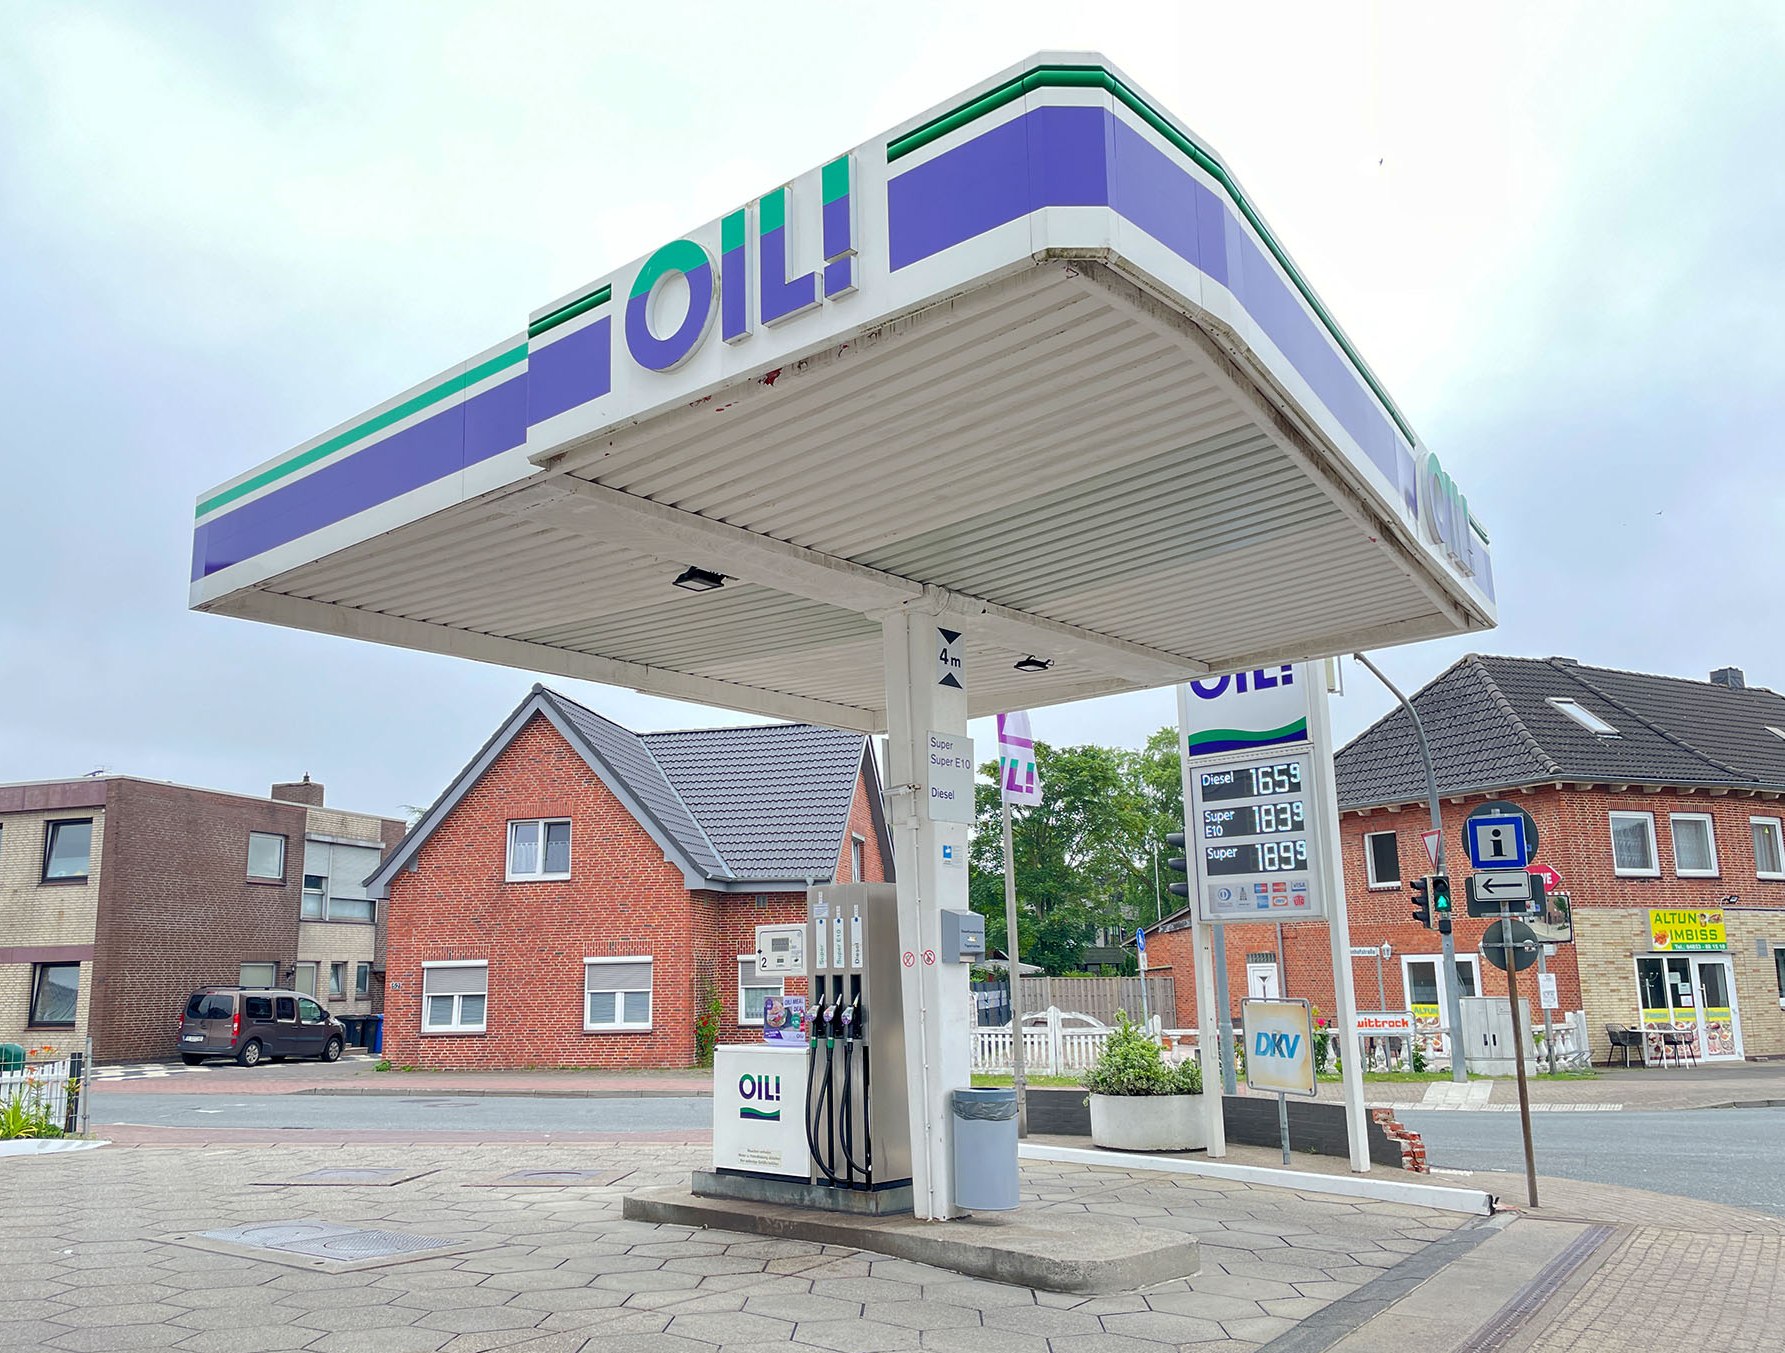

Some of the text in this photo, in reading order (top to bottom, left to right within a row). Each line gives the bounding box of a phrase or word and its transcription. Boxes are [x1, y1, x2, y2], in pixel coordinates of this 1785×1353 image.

[624, 153, 859, 373] OIL!
[939, 648, 961, 668] 4 m
[930, 737, 954, 751] Super
[930, 754, 971, 770] Super E10
[1202, 763, 1301, 796] Diesel 1659
[931, 787, 955, 800] Diesel
[1204, 802, 1304, 833] Super 1839
[1205, 825, 1223, 837] E10
[1207, 841, 1307, 871] Super 1899
[1654, 913, 1697, 924] ALTUN
[1670, 929, 1718, 941] IMBISS
[761, 957, 767, 968] 2
[1414, 1007, 1439, 1015] ALTUN
[1255, 1031, 1301, 1059] DKV
[739, 1073, 781, 1101] OIL!
